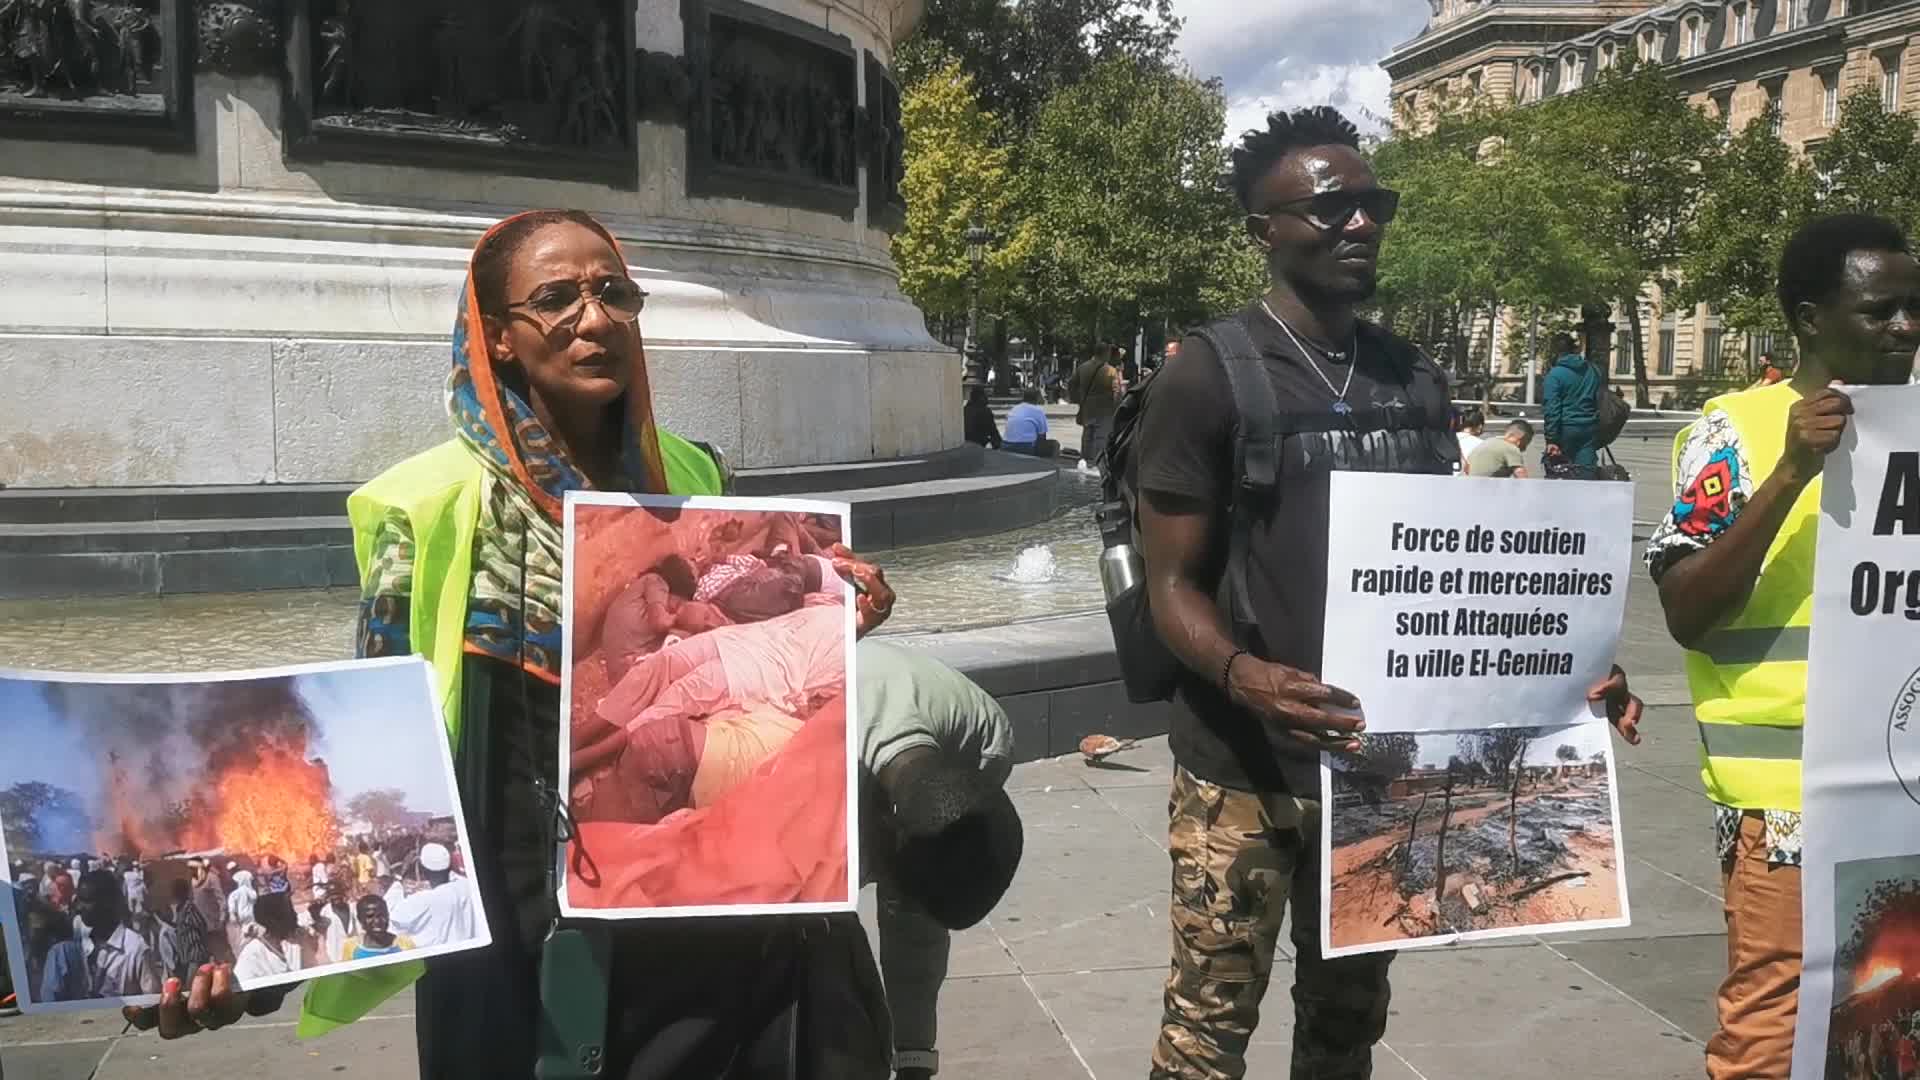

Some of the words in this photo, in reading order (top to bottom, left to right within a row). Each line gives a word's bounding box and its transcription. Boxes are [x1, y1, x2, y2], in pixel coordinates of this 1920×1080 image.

[1391, 522, 1459, 551] Force
[1465, 525, 1494, 553] de
[1500, 527, 1586, 555] soutien
[1351, 565, 1433, 596] rapide
[1439, 568, 1462, 594] et
[1468, 568, 1612, 595] mercenaires
[1396, 609, 1449, 636] sont
[1454, 607, 1569, 638] Attaquées
[1387, 649, 1408, 678] la
[1415, 649, 1464, 677] ville
[1469, 648, 1573, 677] El-Genina
